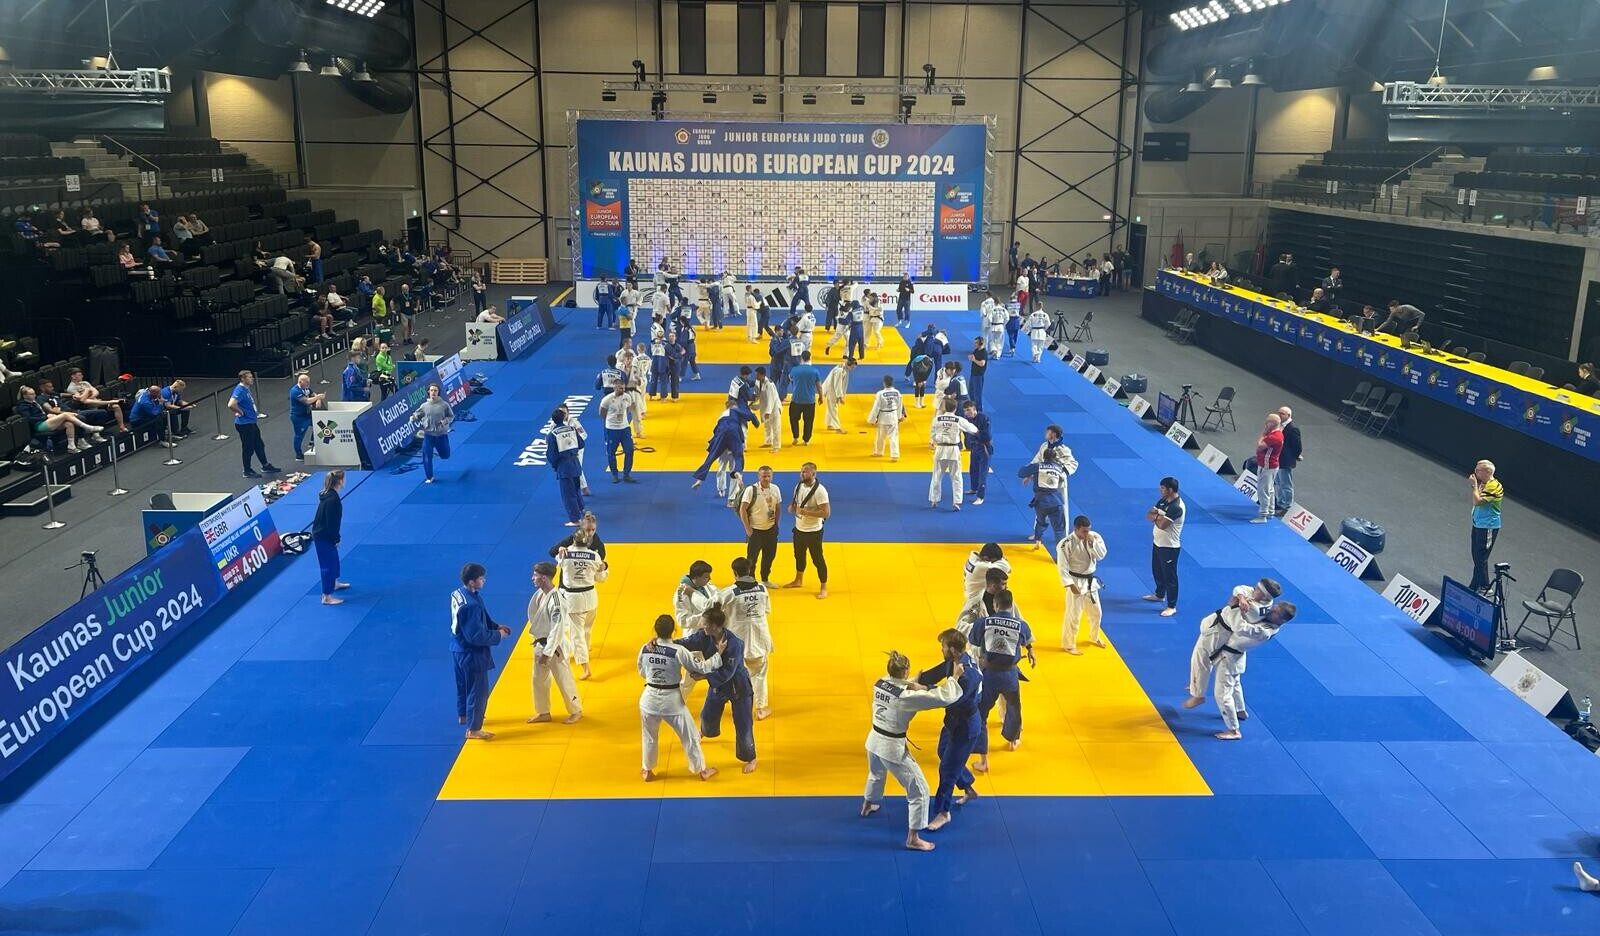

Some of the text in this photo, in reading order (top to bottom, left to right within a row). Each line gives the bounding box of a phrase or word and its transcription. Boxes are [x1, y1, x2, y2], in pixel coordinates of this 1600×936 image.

[724, 132, 864, 144] JUNIOR EUROPEAN JUDO TOUR
[609, 152, 955, 176] KAUNAS JUNIOR EUROPEAN CUP 2024
[920, 293, 960, 303] Canon
[508, 320, 523, 334] Kaunas
[509, 334, 526, 352] European
[379, 399, 409, 426] Kaunas
[378, 420, 415, 455] European
[513, 438, 548, 466] 2024
[1238, 484, 1256, 499] .COM
[213, 503, 252, 537] GBR 0
[224, 526, 262, 562] UKR 0
[242, 544, 268, 575] 4:00
[1331, 552, 1359, 574] .COM
[6, 567, 165, 692] Kaunas Junior
[1456, 622, 1475, 640] 4:00
[0, 583, 203, 758] European Cup 2024
[649, 657, 666, 665] GBR
[876, 692, 890, 703] GBR
